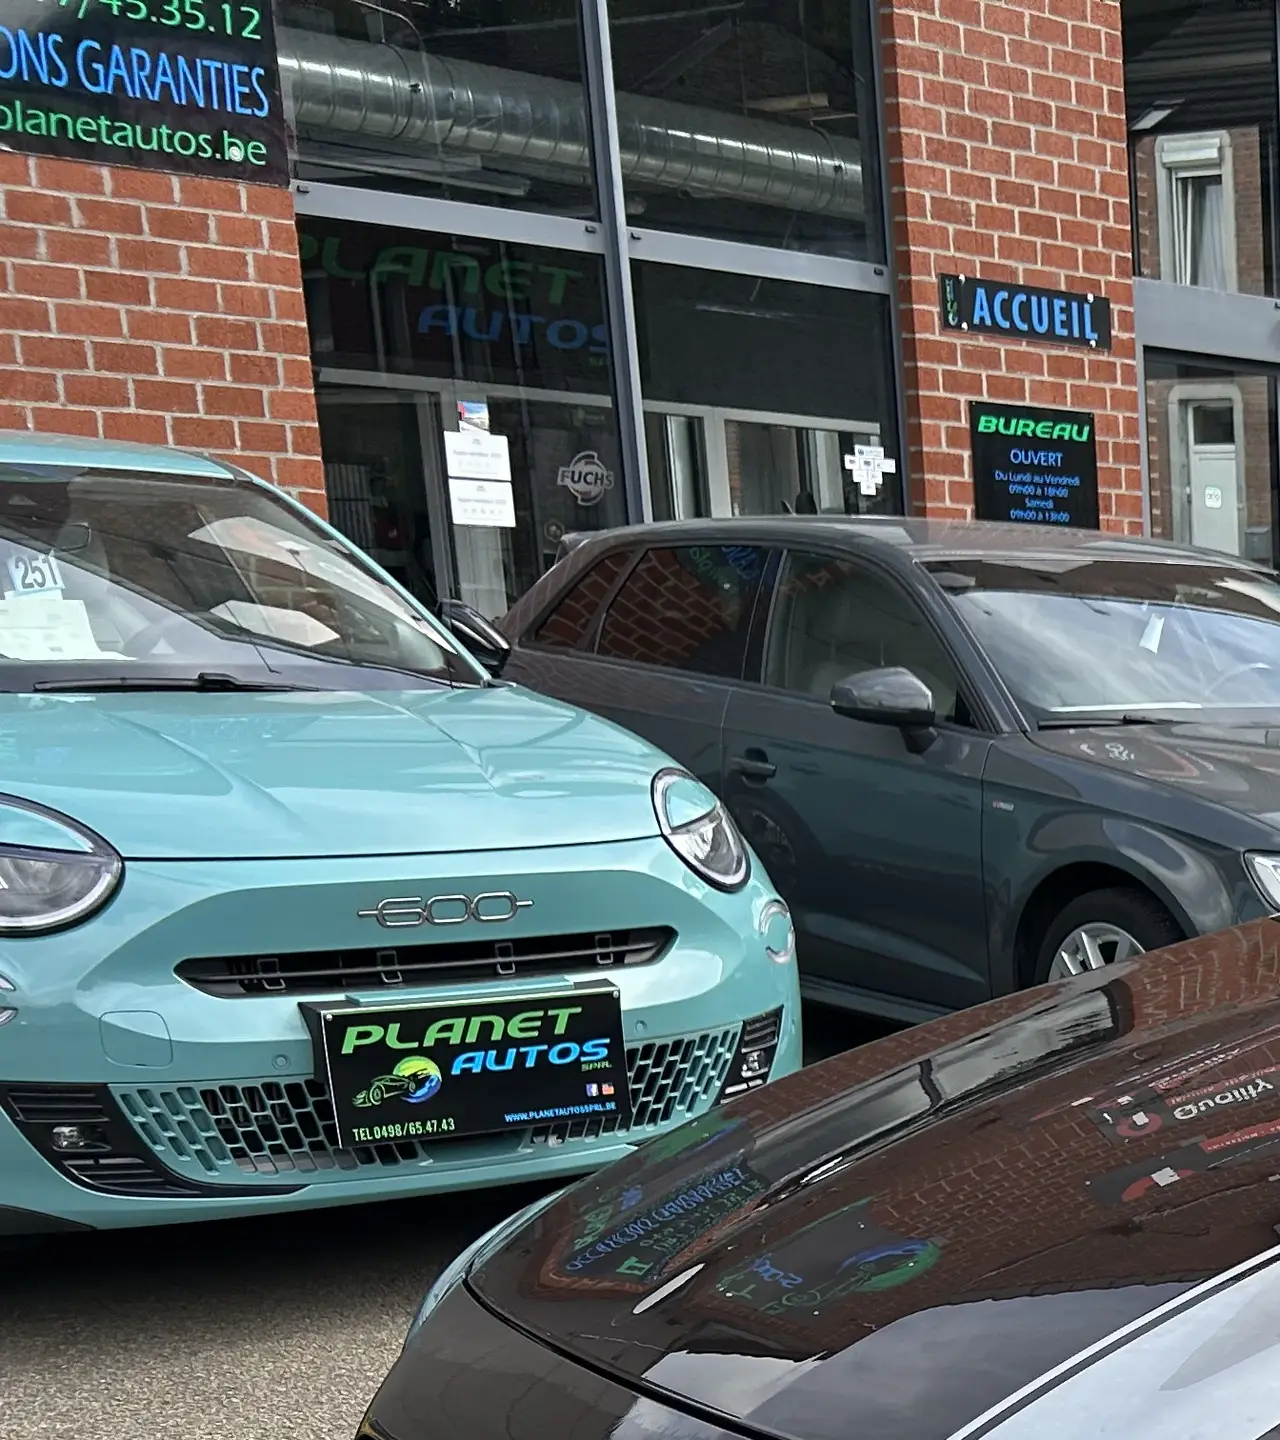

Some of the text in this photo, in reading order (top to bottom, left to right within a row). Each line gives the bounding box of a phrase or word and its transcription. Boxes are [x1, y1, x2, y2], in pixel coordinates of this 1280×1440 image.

[76, 39, 269, 117] GARANTIES
[973, 287, 1099, 341] ACCUEIL
[977, 415, 1090, 443] BUREAU
[1010, 448, 1064, 468] OUVERT
[557, 467, 614, 488] FUCHS
[994, 469, 1008, 481] Du
[1009, 471, 1032, 482] Lundi
[1045, 473, 1080, 487] Vendredi
[1025, 497, 1054, 509] Samedi
[14, 555, 58, 590] 251
[376, 889, 518, 929] 600
[341, 1006, 583, 1055] PLANET
[451, 1037, 611, 1076] AUTOS
